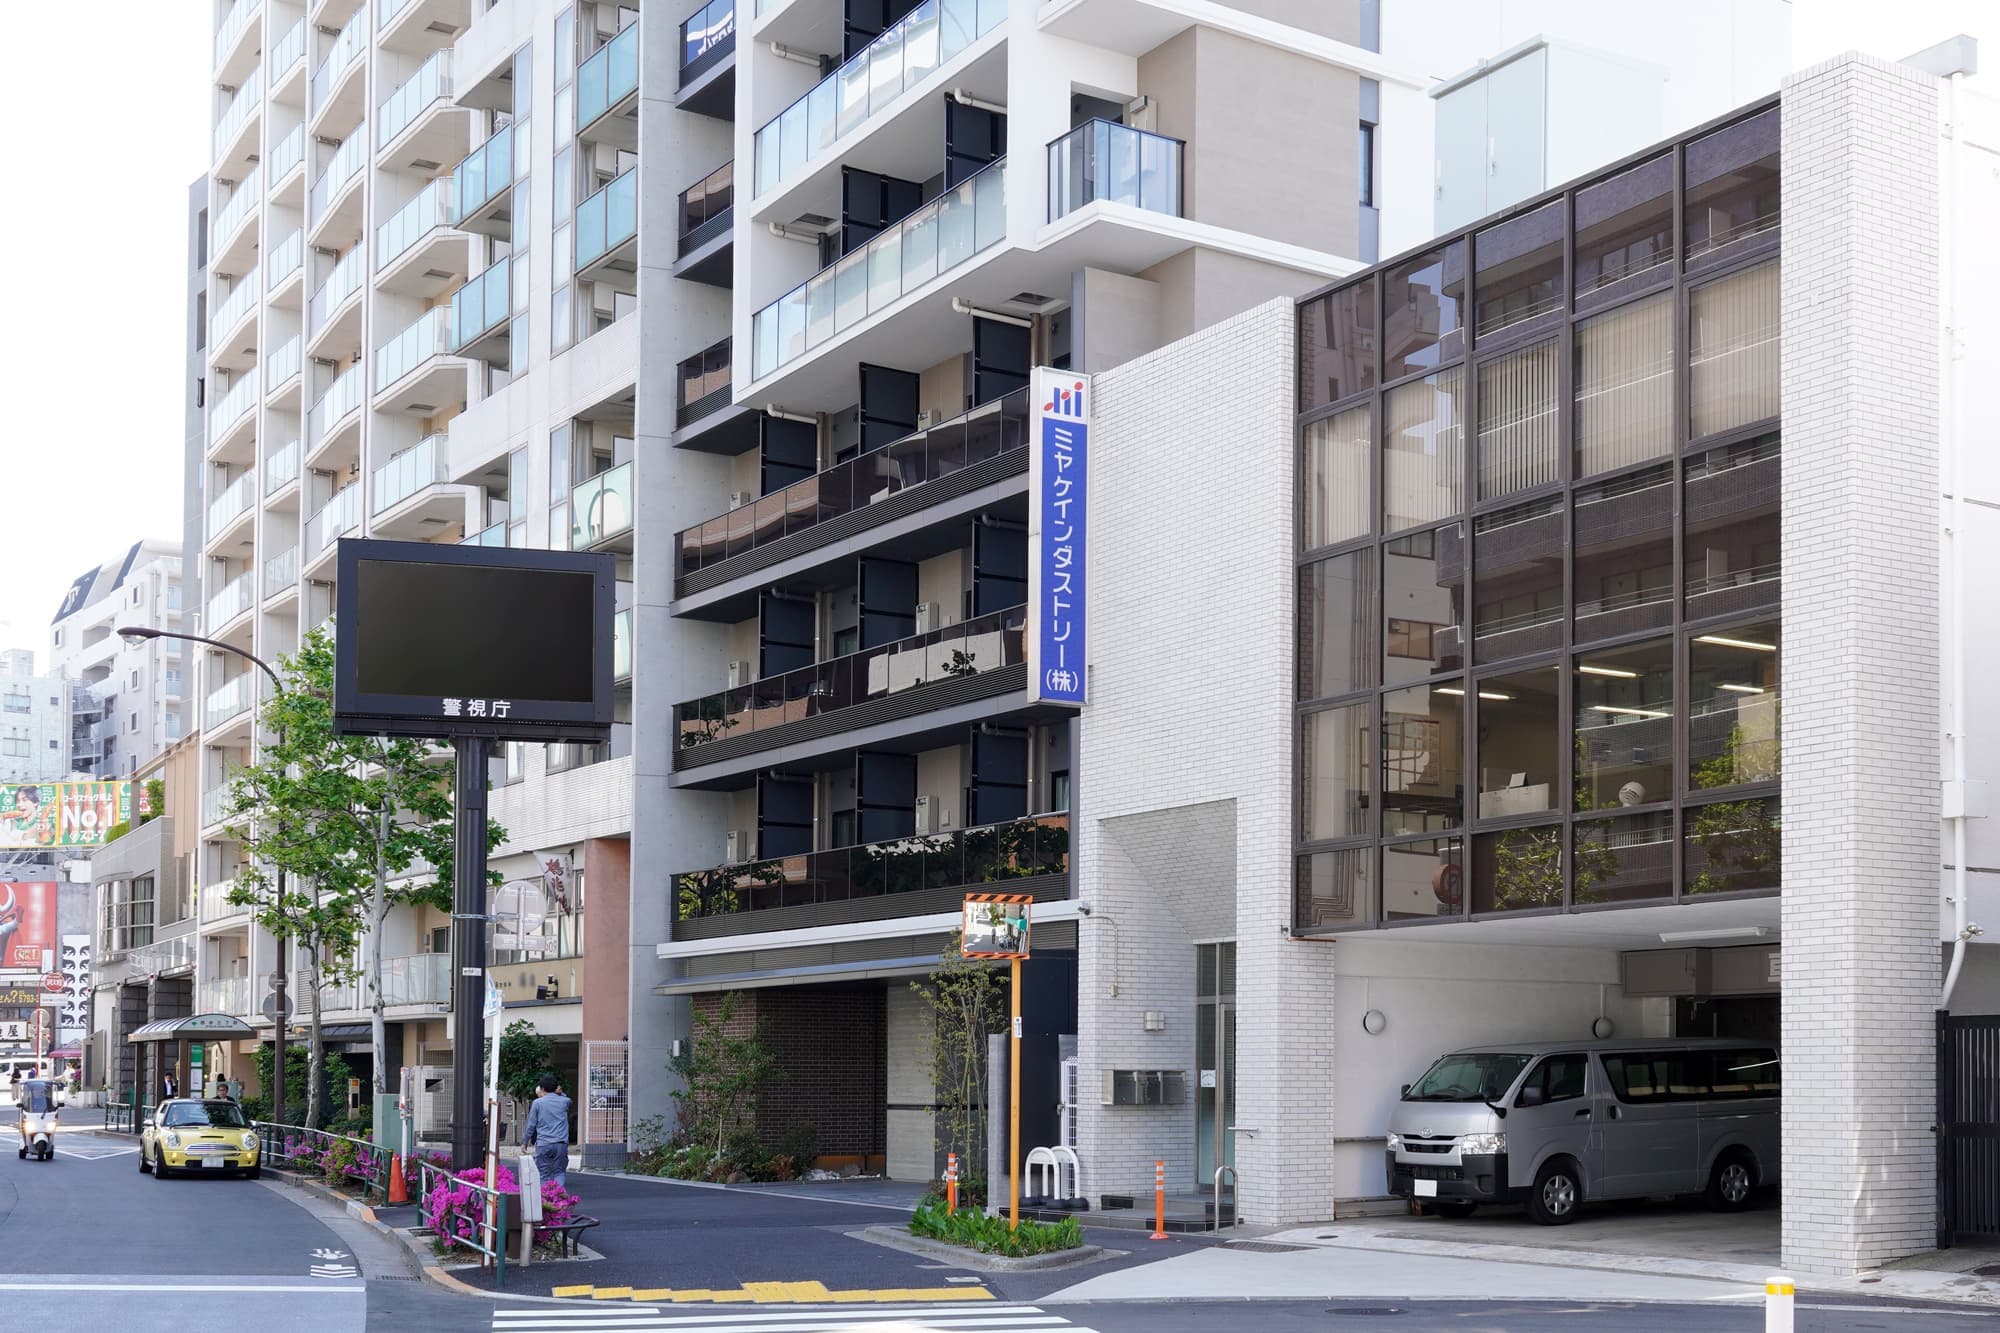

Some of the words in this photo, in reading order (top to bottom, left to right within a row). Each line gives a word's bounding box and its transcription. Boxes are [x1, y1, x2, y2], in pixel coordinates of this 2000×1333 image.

[1046, 427, 1079, 693] ミヤケインダストリー(株)
[442, 698, 512, 719] 警視庁
[63, 802, 113, 828] No.1
